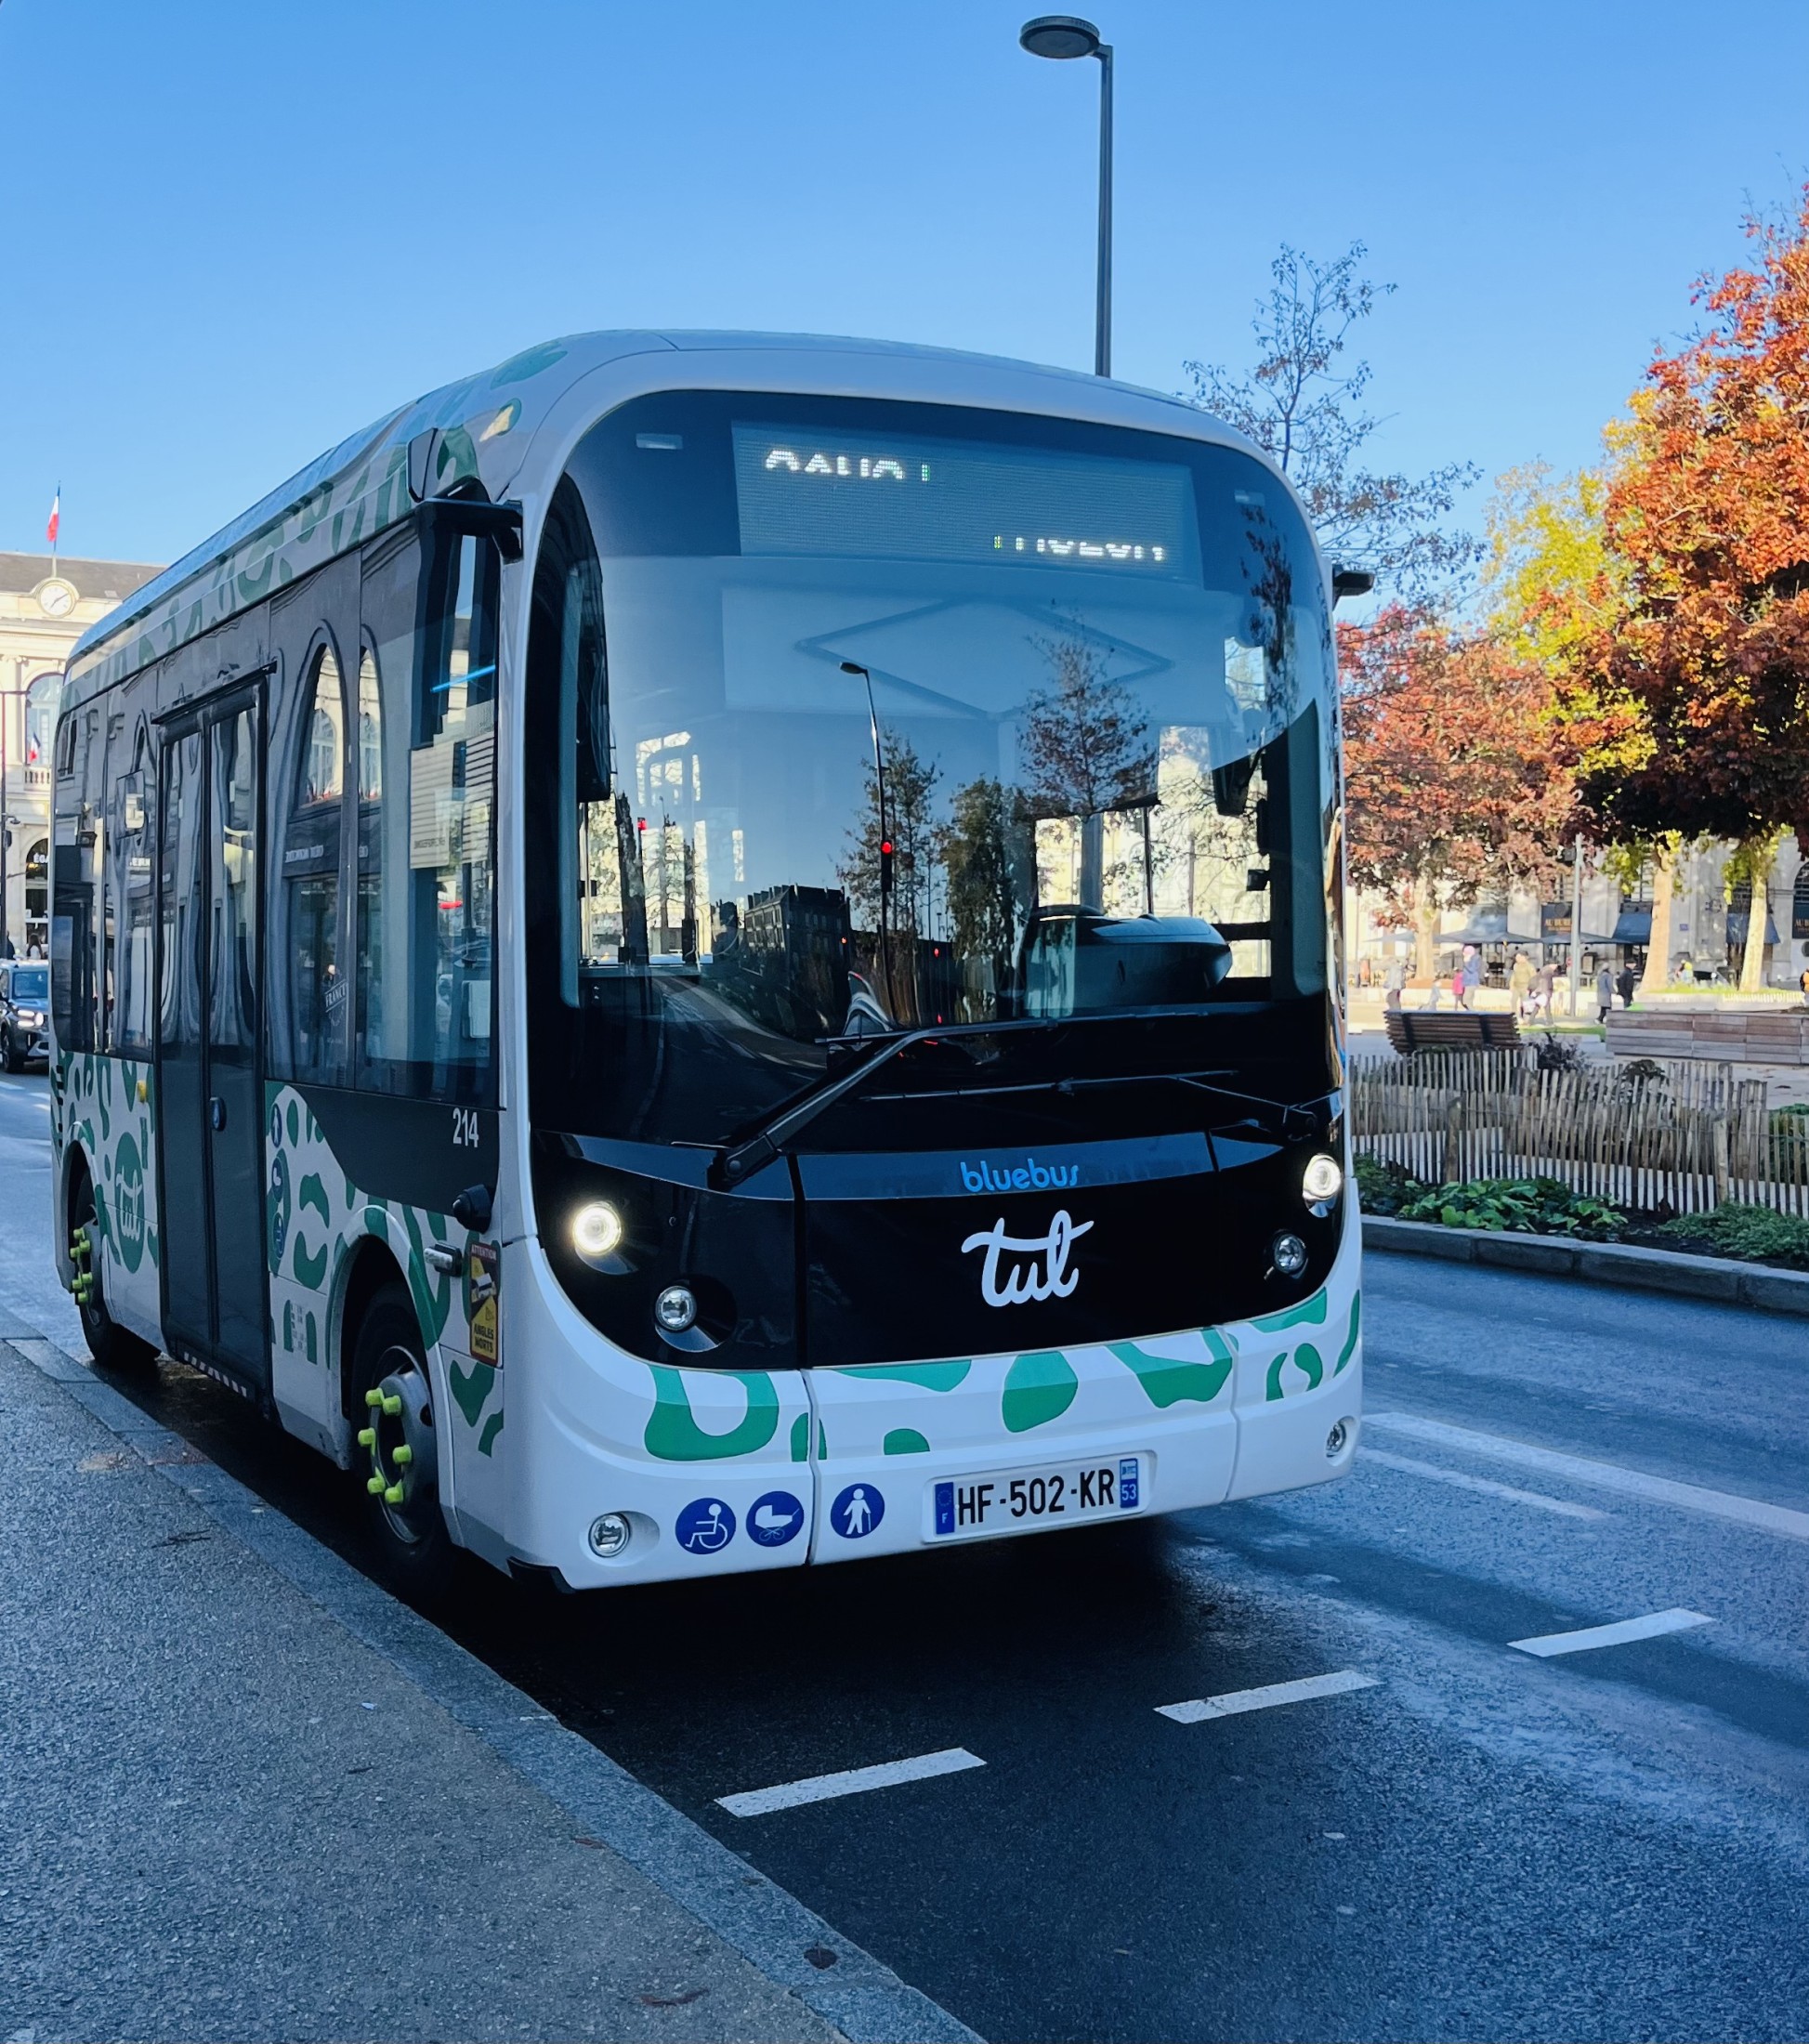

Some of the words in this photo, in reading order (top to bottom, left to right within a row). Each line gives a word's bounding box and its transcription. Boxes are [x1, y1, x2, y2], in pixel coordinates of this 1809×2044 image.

[452, 1107, 479, 1148] 214
[960, 1158, 1080, 1193] bluebus
[471, 1244, 497, 1261] ATTENTION
[474, 1324, 494, 1340] ANGLES
[475, 1336, 493, 1354] MORTS
[941, 1513, 949, 1524] F
[958, 1468, 1115, 1526] HF-502-KR
[1121, 1484, 1136, 1501] 53
